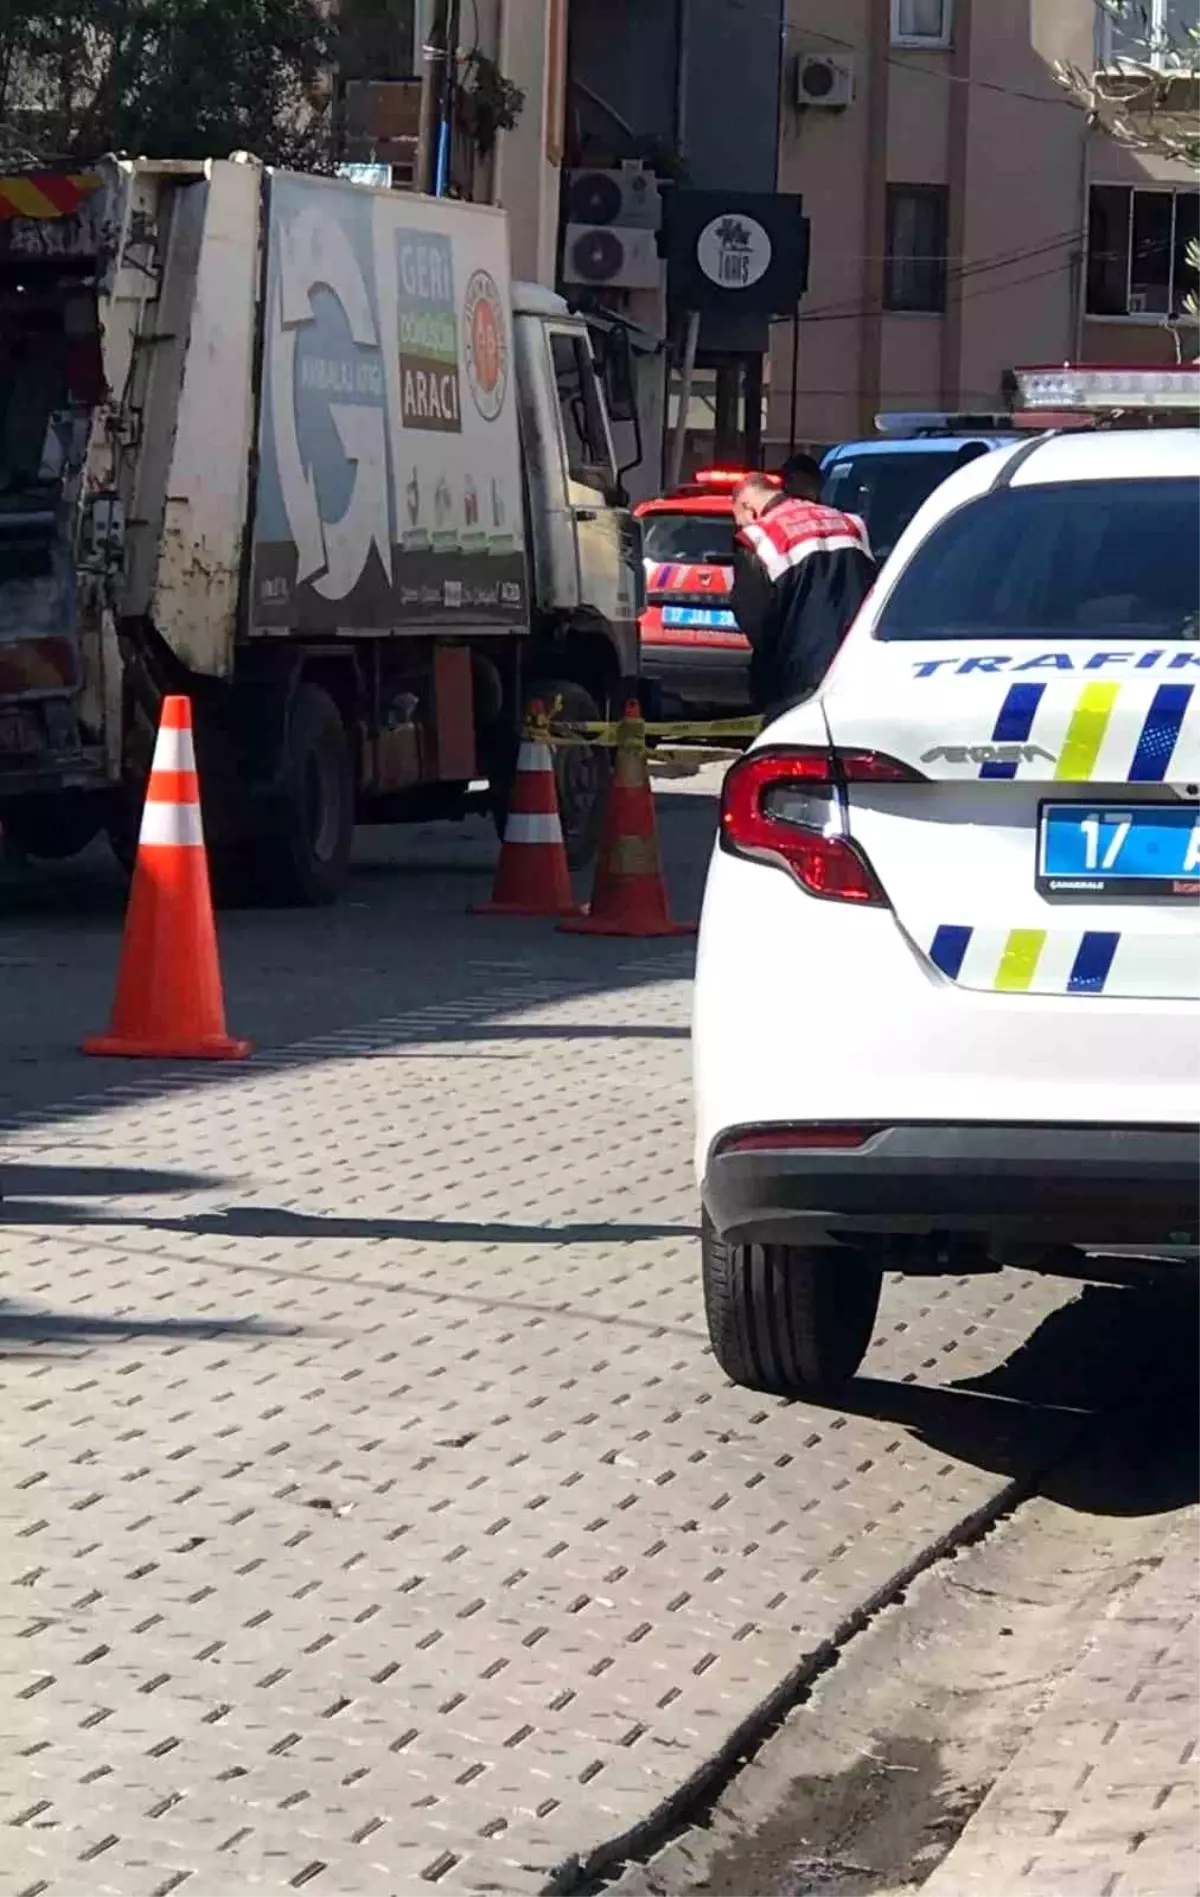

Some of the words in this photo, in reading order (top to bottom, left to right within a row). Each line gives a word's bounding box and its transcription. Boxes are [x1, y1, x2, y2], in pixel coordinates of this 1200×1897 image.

[403, 369, 458, 420] ARACI
[912, 649, 1200, 678] TRAFİK
[1080, 812, 1133, 869] 17
